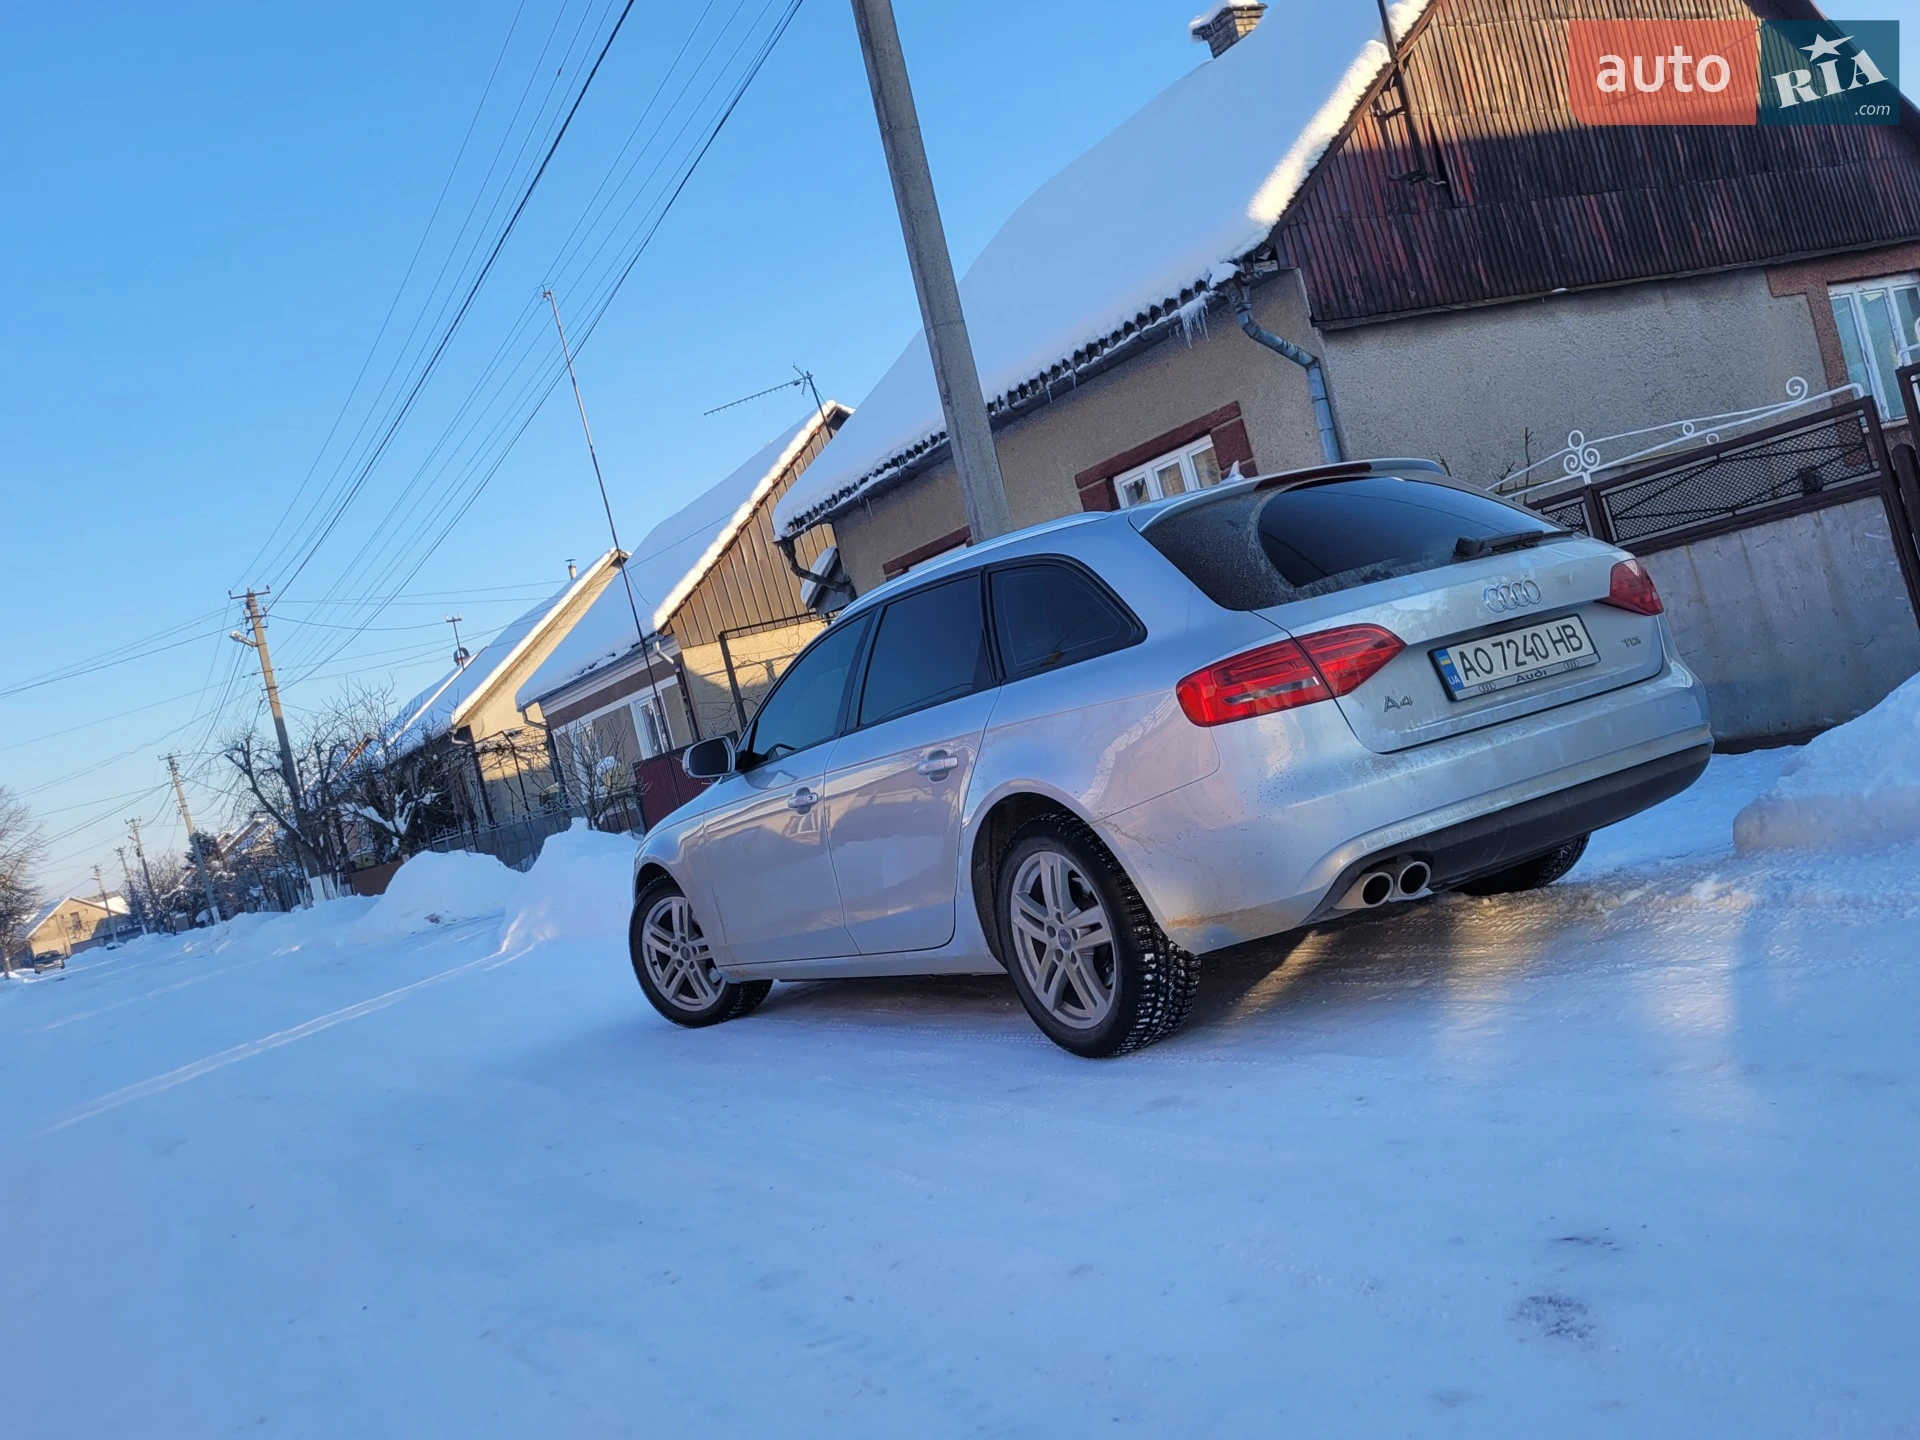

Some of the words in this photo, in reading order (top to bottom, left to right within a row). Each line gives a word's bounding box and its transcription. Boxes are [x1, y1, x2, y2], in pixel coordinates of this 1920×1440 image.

[1459, 647, 1494, 681] AO
[1491, 632, 1550, 671] 7240
[1546, 624, 1583, 657] HB
[1448, 675, 1461, 685] UA
[1515, 669, 1547, 683] Audi
[1383, 694, 1414, 713] A4
